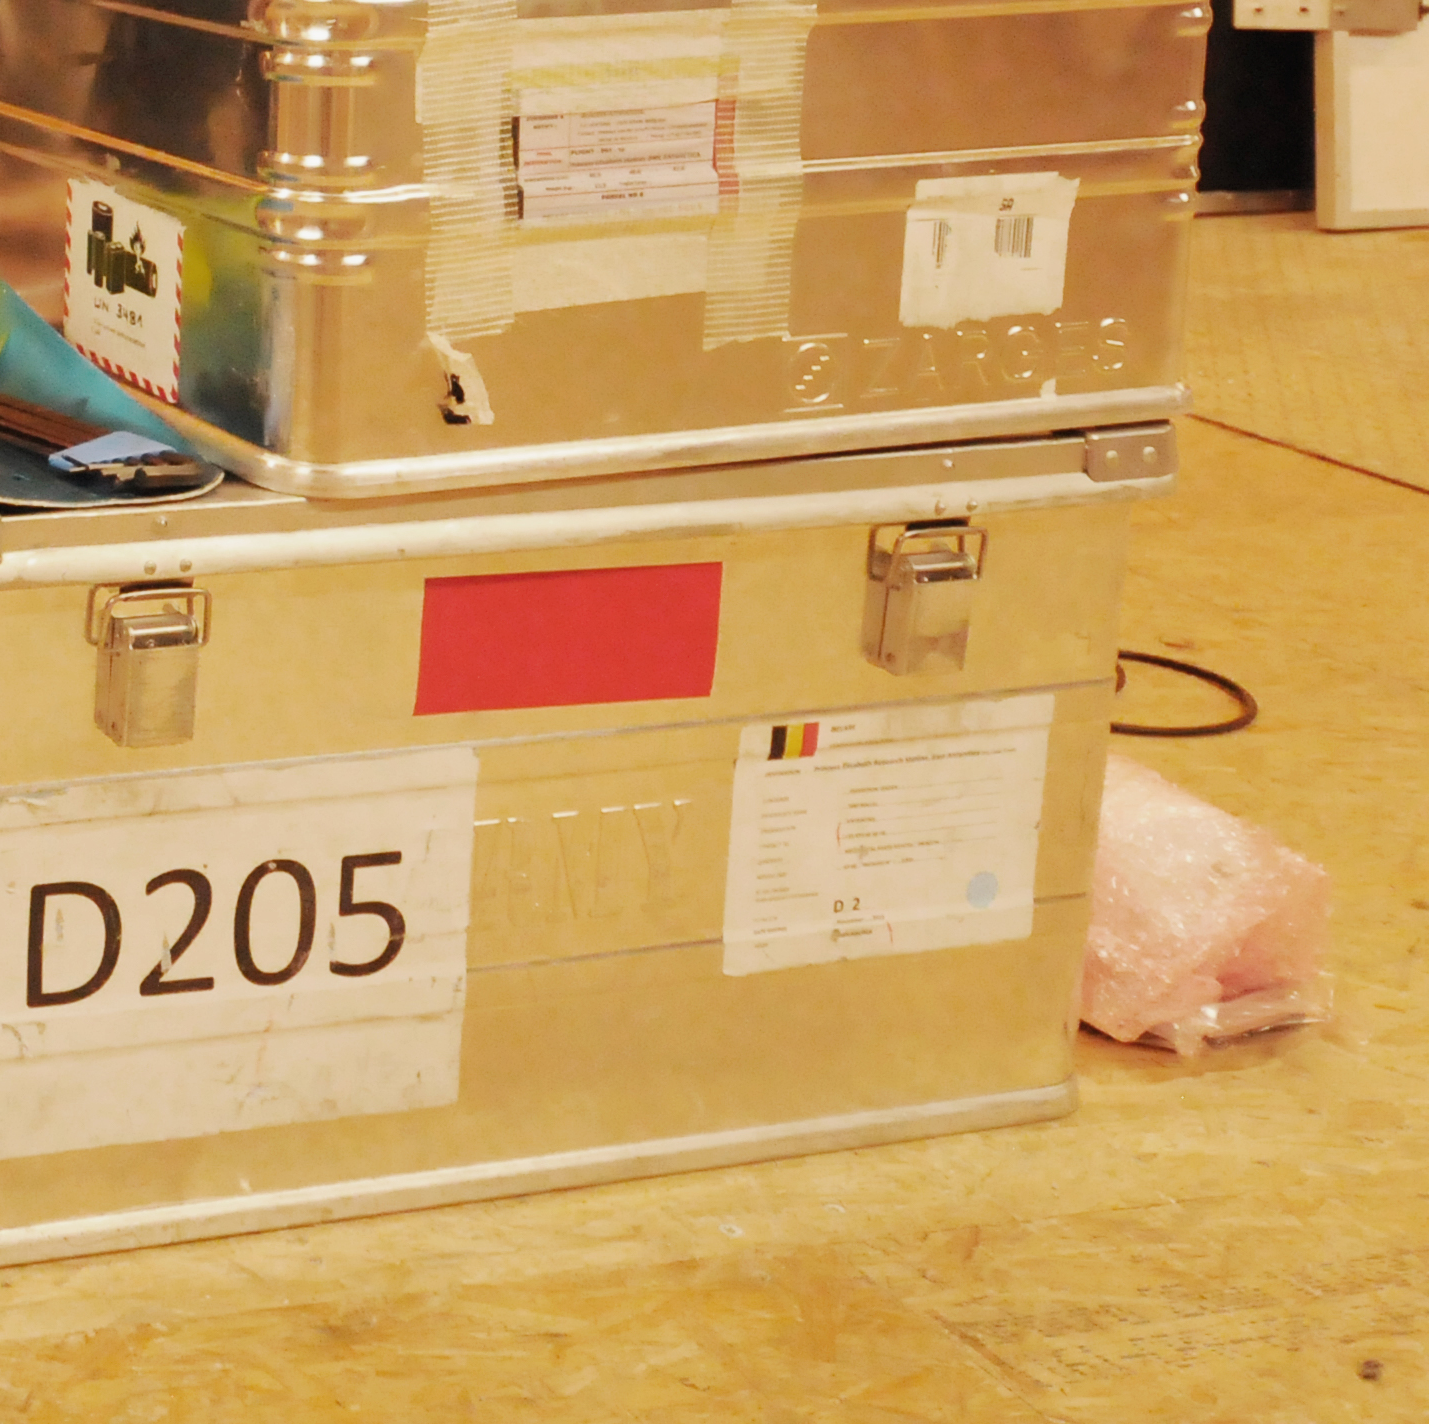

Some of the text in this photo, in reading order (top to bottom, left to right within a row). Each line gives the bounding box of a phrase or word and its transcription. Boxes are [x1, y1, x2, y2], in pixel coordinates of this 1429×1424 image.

[94, 296, 143, 328] UN 3481
[860, 317, 1131, 399] ZARGES
[27, 851, 406, 1008] D205
[833, 897, 861, 913] D 2
